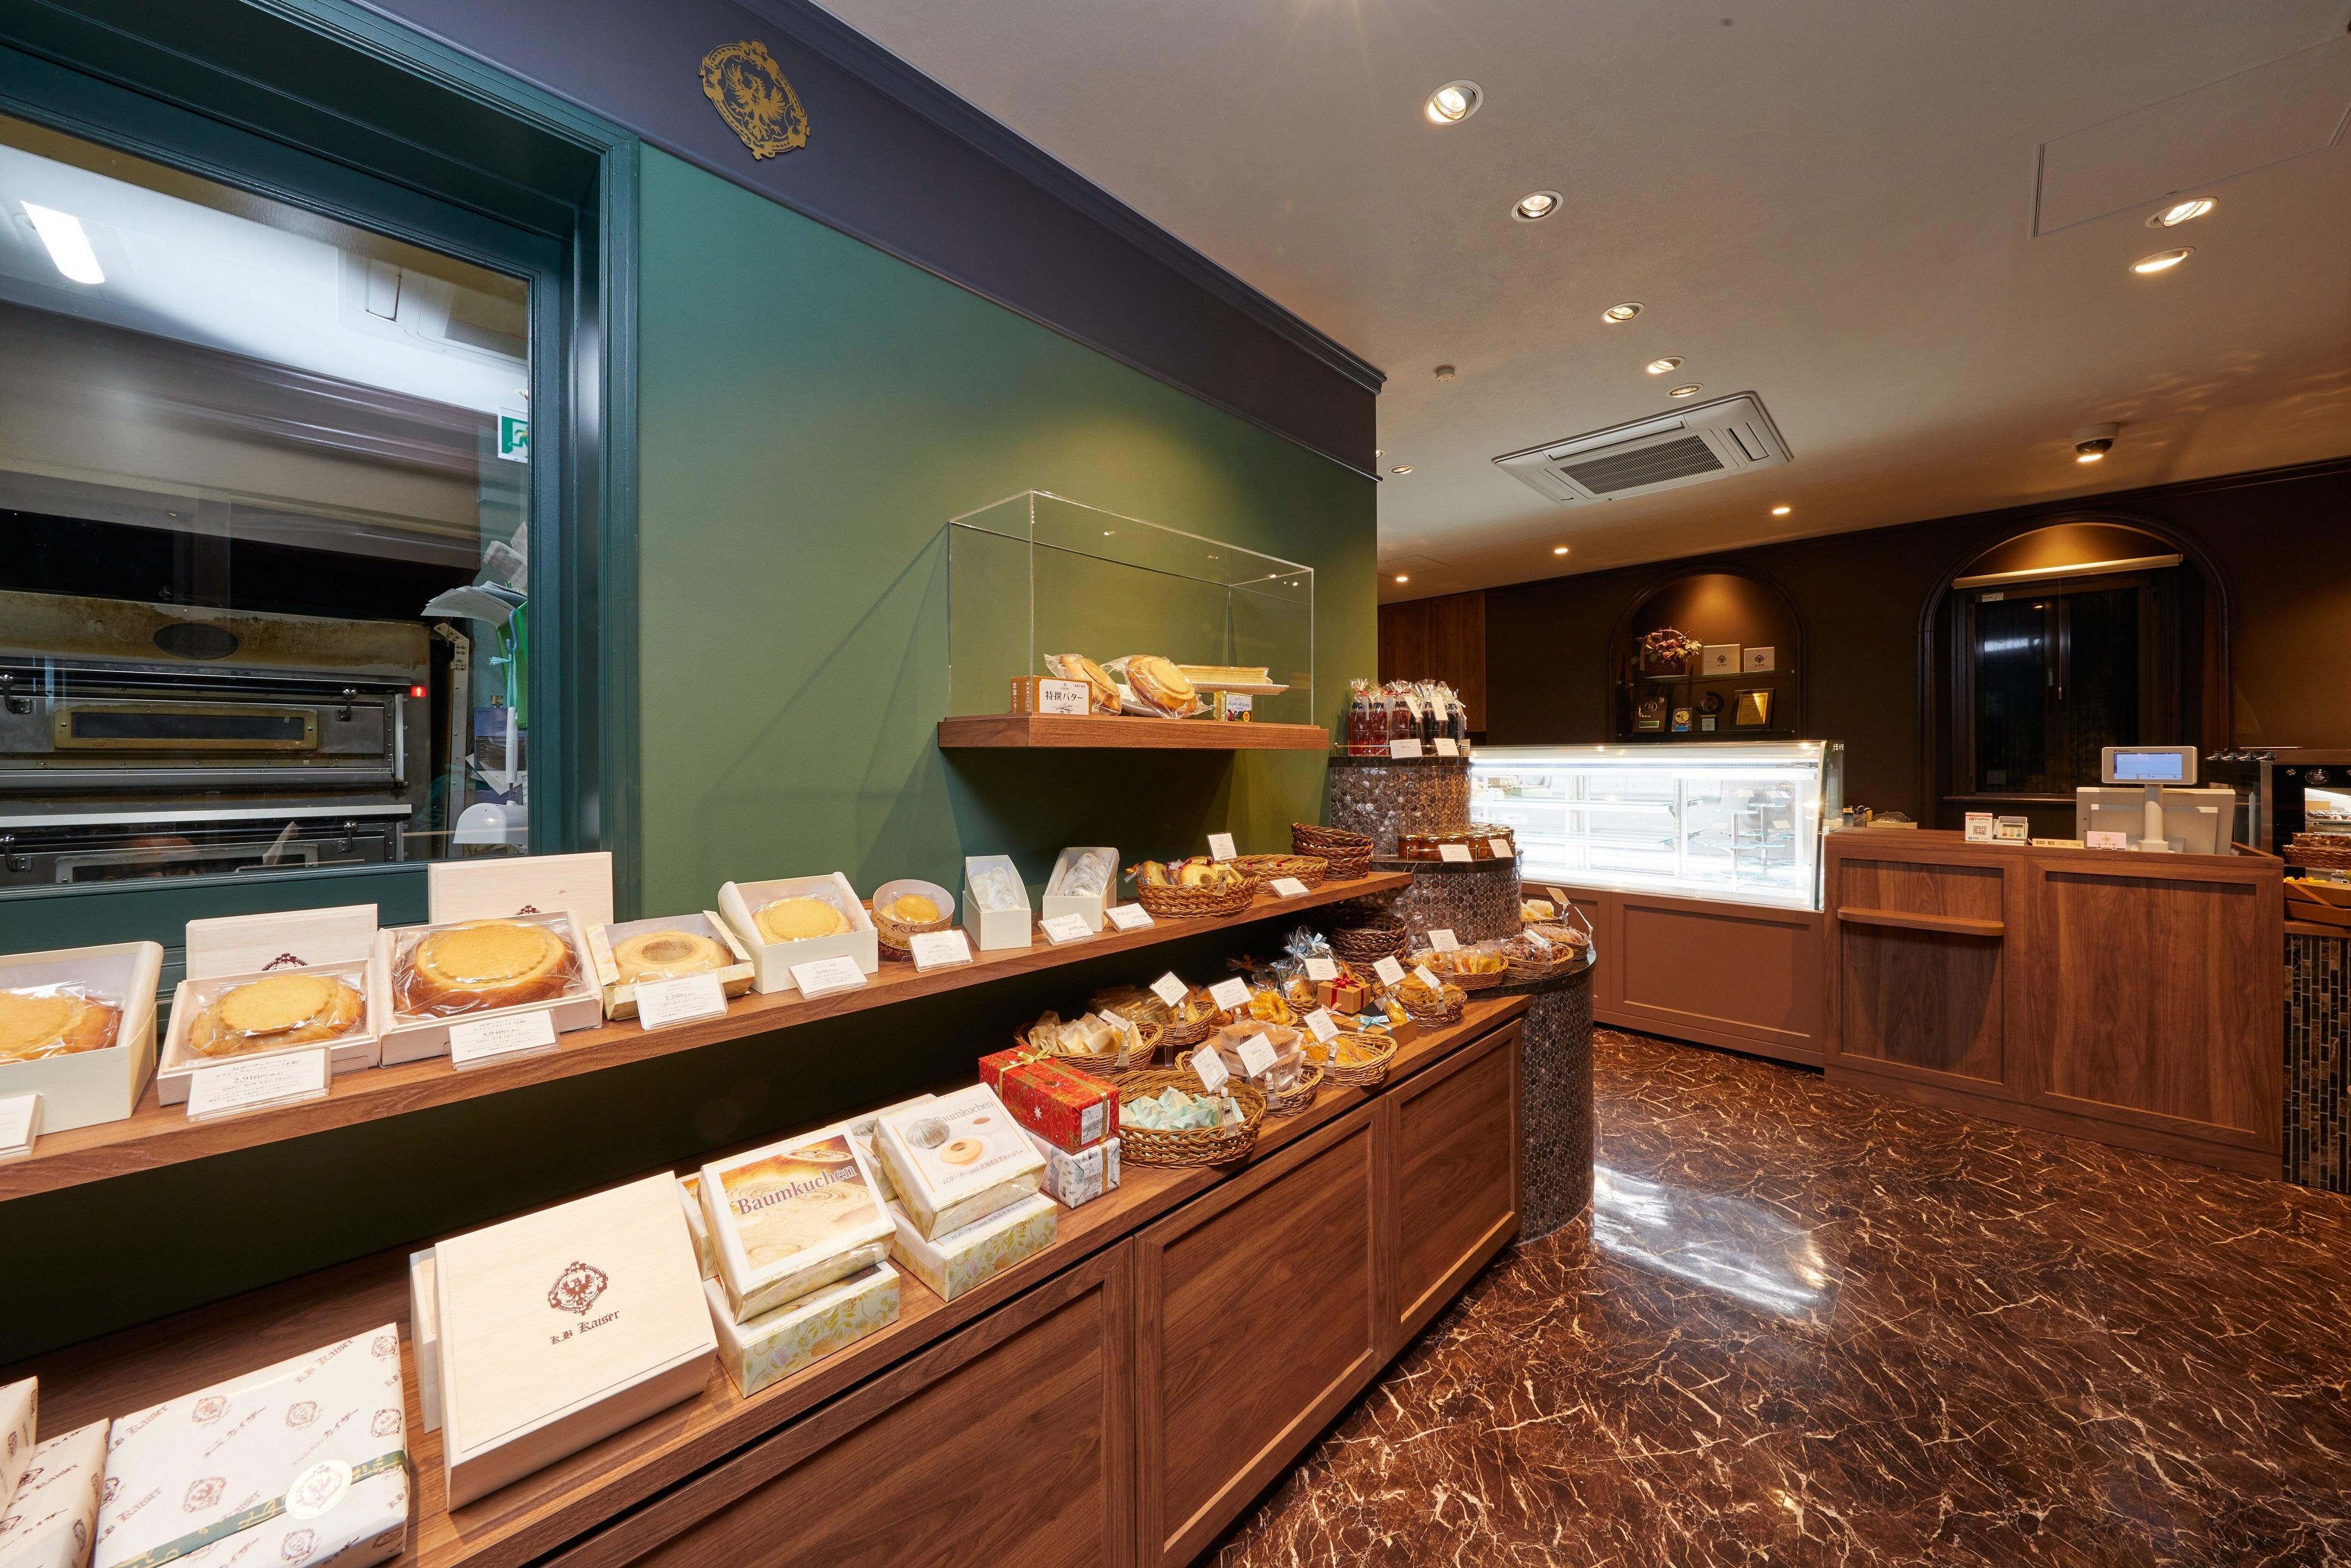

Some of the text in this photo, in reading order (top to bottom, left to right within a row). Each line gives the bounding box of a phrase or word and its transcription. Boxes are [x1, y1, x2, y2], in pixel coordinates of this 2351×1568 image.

[1045, 690, 1083, 702] 特撰バター
[934, 1100, 994, 1125] Baumkuchen
[969, 1167, 980, 1175] und
[736, 1165, 857, 1216] Baumkuchen
[577, 1311, 620, 1334] Kaiser
[315, 1338, 354, 1367] Kaiser
[125, 1405, 168, 1436] Kaiser
[116, 1487, 163, 1523] Kaiser
